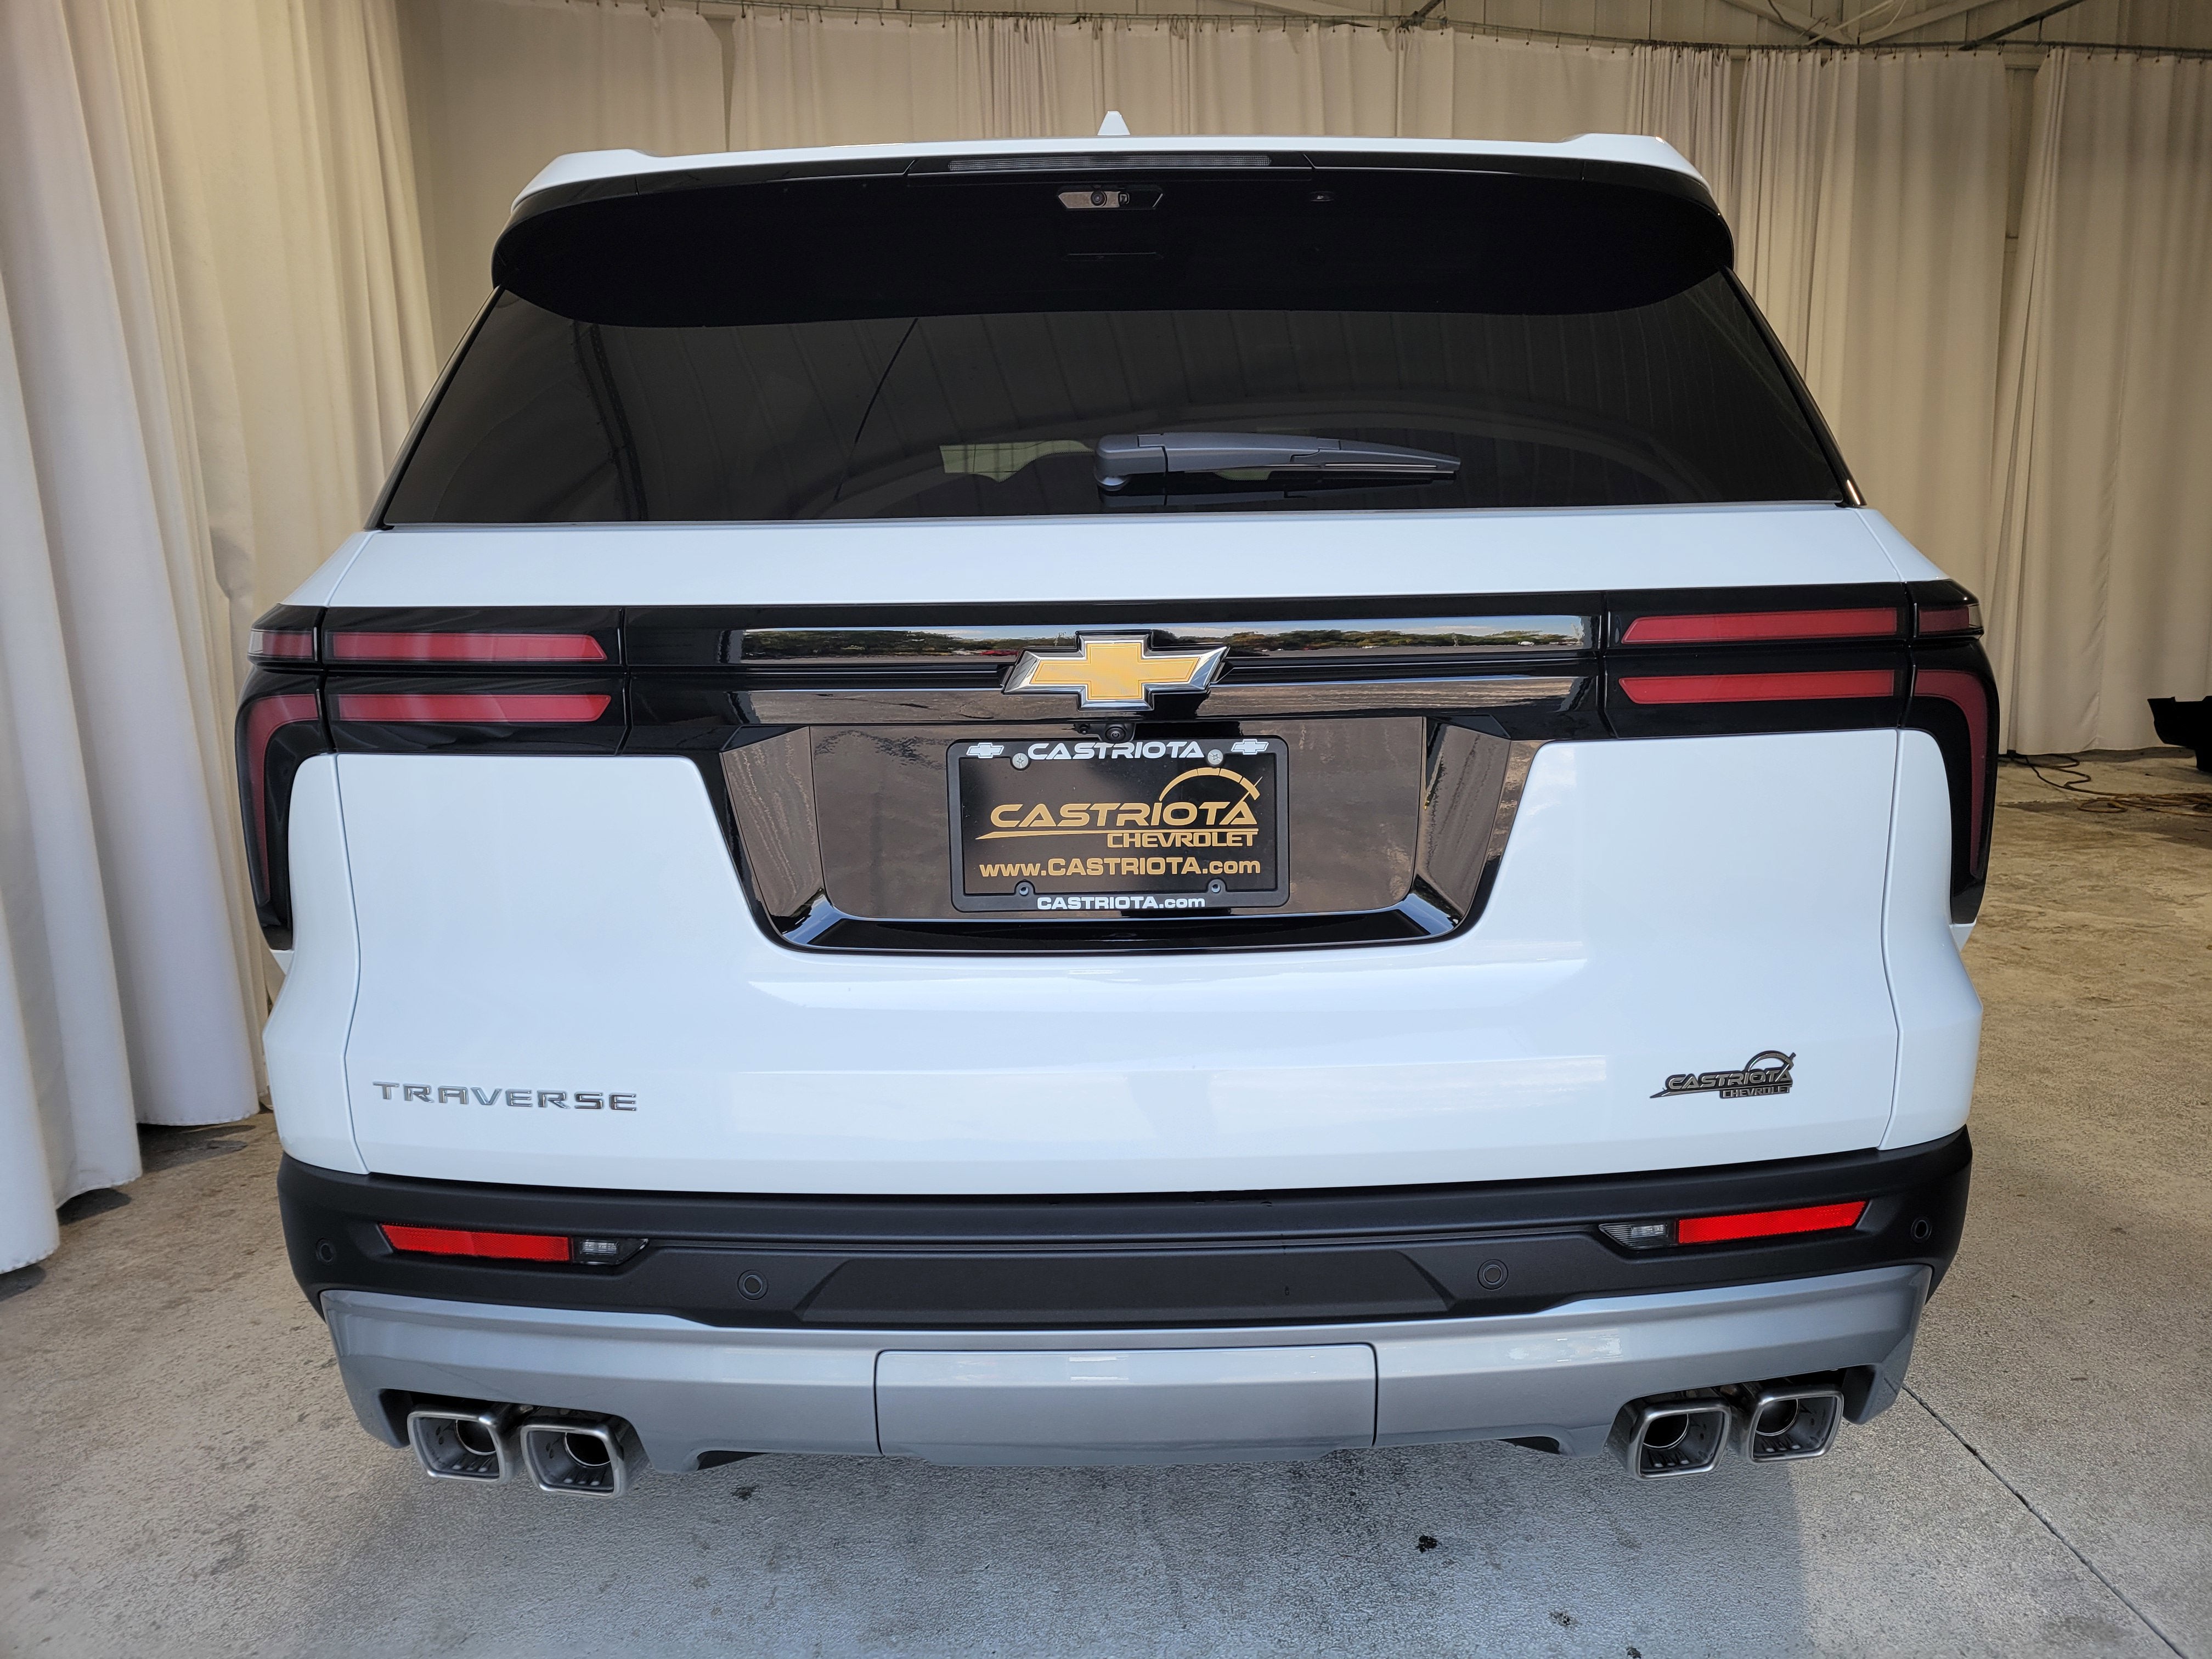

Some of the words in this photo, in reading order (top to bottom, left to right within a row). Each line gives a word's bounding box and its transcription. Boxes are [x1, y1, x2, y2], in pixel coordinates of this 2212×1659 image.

[1028, 741, 1204, 760] CASTRIOTA
[990, 801, 1258, 827] CASTRIOTA
[1107, 832, 1258, 848] CHEVROLET
[979, 857, 1260, 877] www.CASTRIOTA.com
[1037, 896, 1205, 910] CASTRIOTA.com
[1667, 1070, 1792, 1090] CASTRIOTA
[373, 1081, 637, 1111] TRAVERSE
[1723, 1085, 1792, 1098] CHEVROLET
